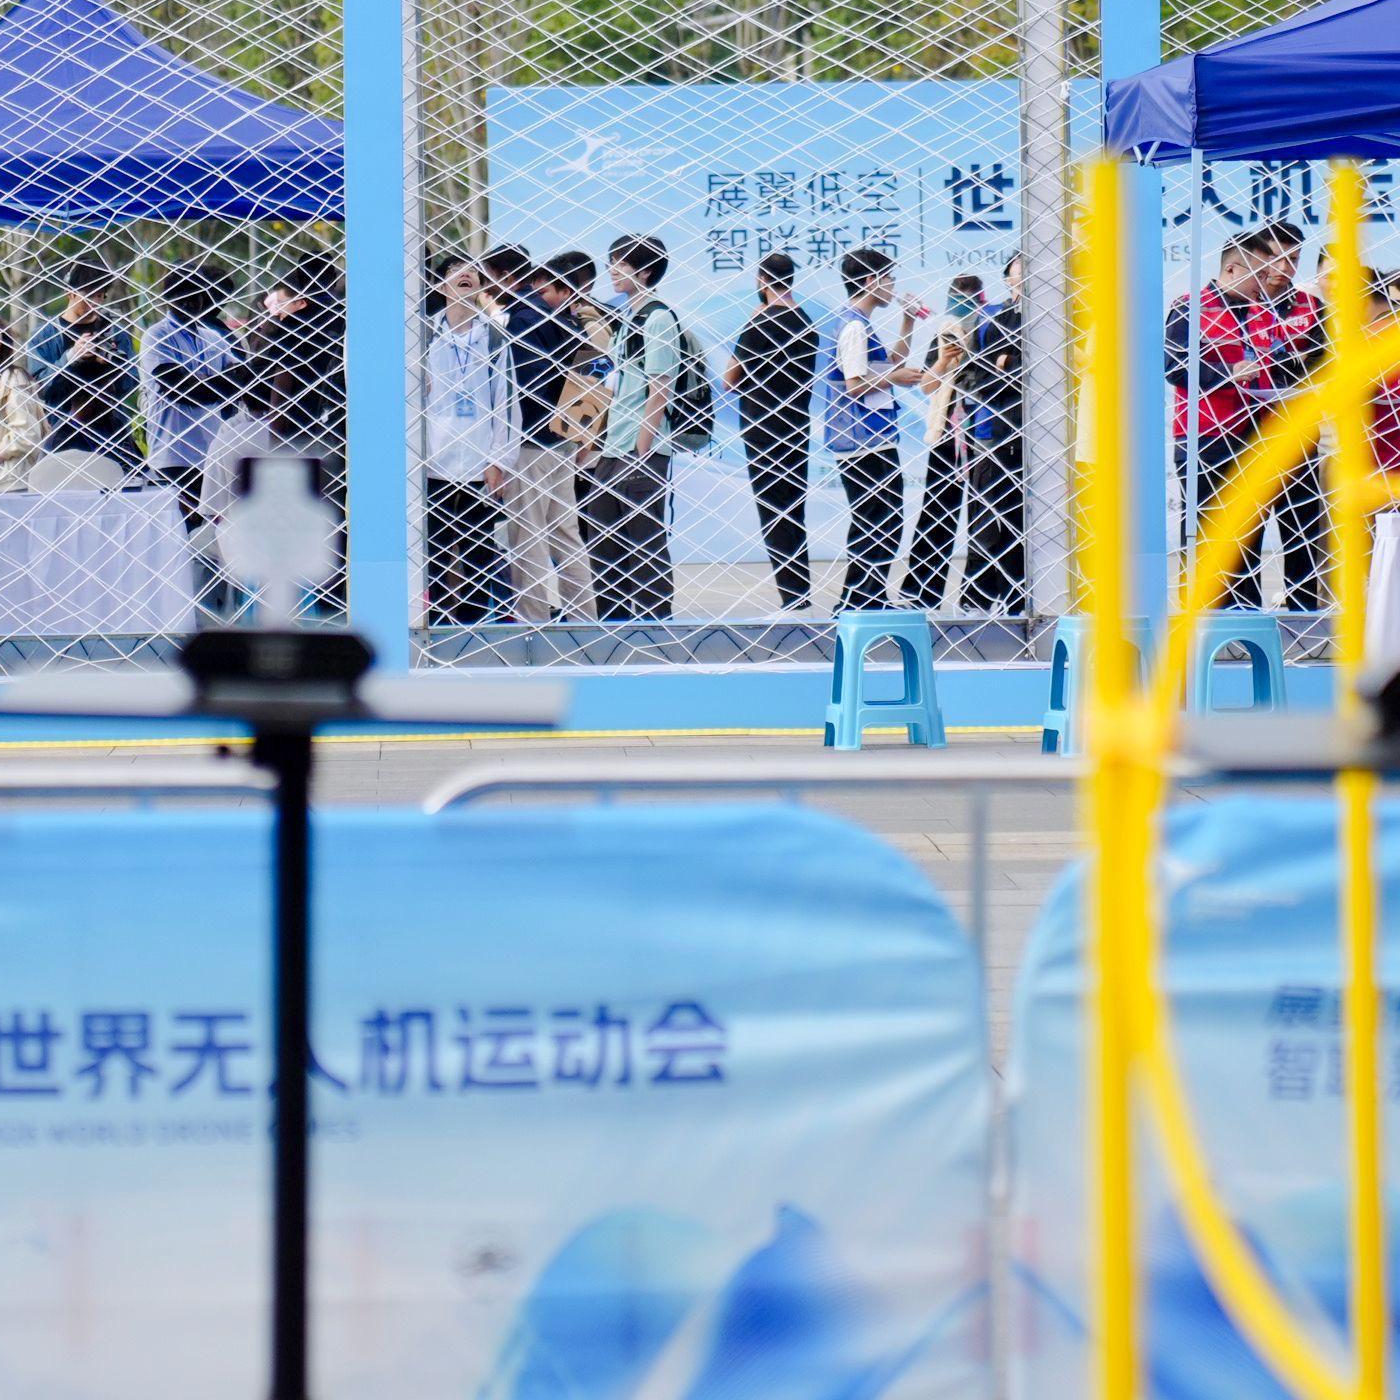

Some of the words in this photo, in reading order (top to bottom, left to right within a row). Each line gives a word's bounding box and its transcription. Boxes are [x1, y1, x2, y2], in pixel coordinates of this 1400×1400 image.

[703, 168, 901, 219] 展翼低空
[945, 250, 1013, 269] WORL
